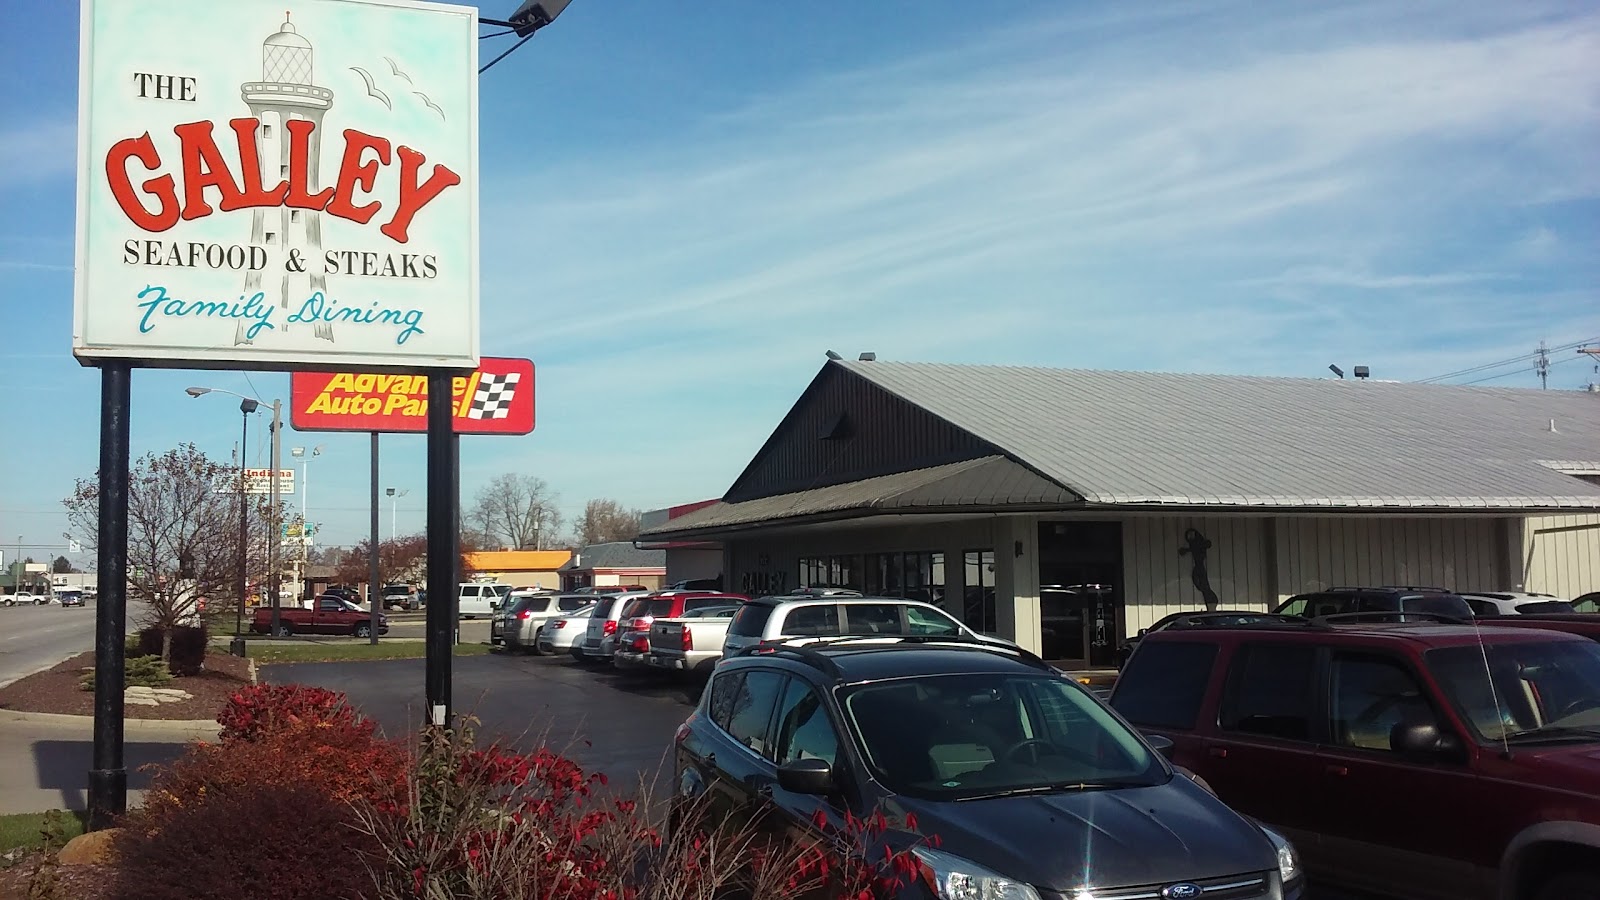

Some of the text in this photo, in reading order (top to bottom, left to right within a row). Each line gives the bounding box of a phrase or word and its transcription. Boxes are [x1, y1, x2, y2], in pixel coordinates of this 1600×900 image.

[134, 72, 197, 102] THE
[105, 117, 461, 244] GALLEY
[123, 240, 438, 279] SEAFOOD & STEAKS
[138, 284, 425, 345] Family Dining
[324, 373, 467, 397] Advane
[305, 391, 460, 417] Auto Pars
[246, 469, 292, 478] Indina
[1173, 885, 1195, 898] Ford
